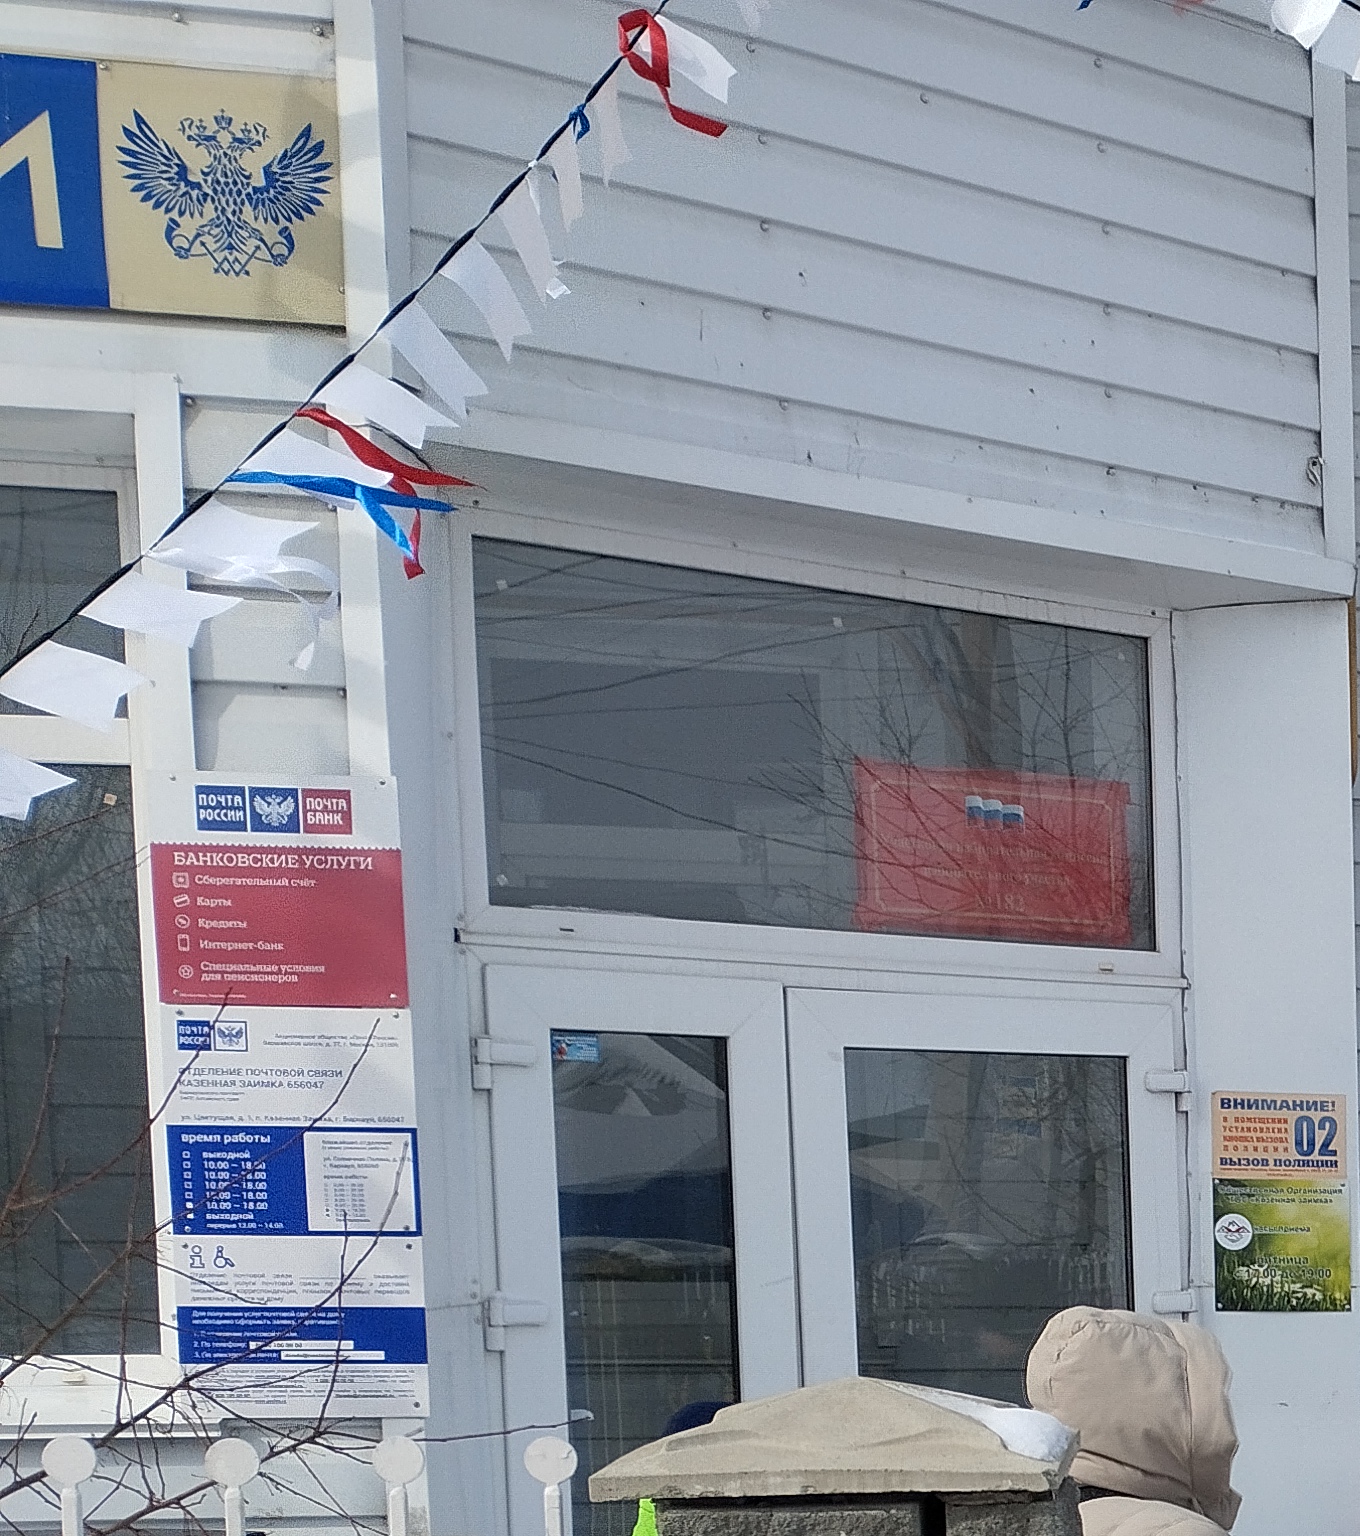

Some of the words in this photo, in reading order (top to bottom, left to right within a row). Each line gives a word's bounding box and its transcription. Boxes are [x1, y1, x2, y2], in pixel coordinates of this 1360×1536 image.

[198, 794, 243, 807] ПОЧТА
[306, 797, 348, 811] ПОЧТА
[199, 809, 244, 822] РОССИИ
[306, 812, 343, 825] БАНК
[173, 851, 299, 868] БАНКОВСКИЕ
[301, 855, 373, 870] УСЛУГИ
[196, 896, 232, 908] Карты
[245, 1067, 304, 1078] ПОЧТОВОЙ
[307, 1069, 343, 1078] СВЯЗИ
[1220, 1097, 1335, 1112] ВНИМАНИЕ!
[1234, 1116, 1288, 1125] ПОМЕЩЕНИИ
[223, 1132, 271, 1145] работы
[1294, 1115, 1338, 1157] 02
[1219, 1157, 1270, 1167] ВЫЗОВ
[1273, 1158, 1338, 1169] ПОЛИЦИИ
